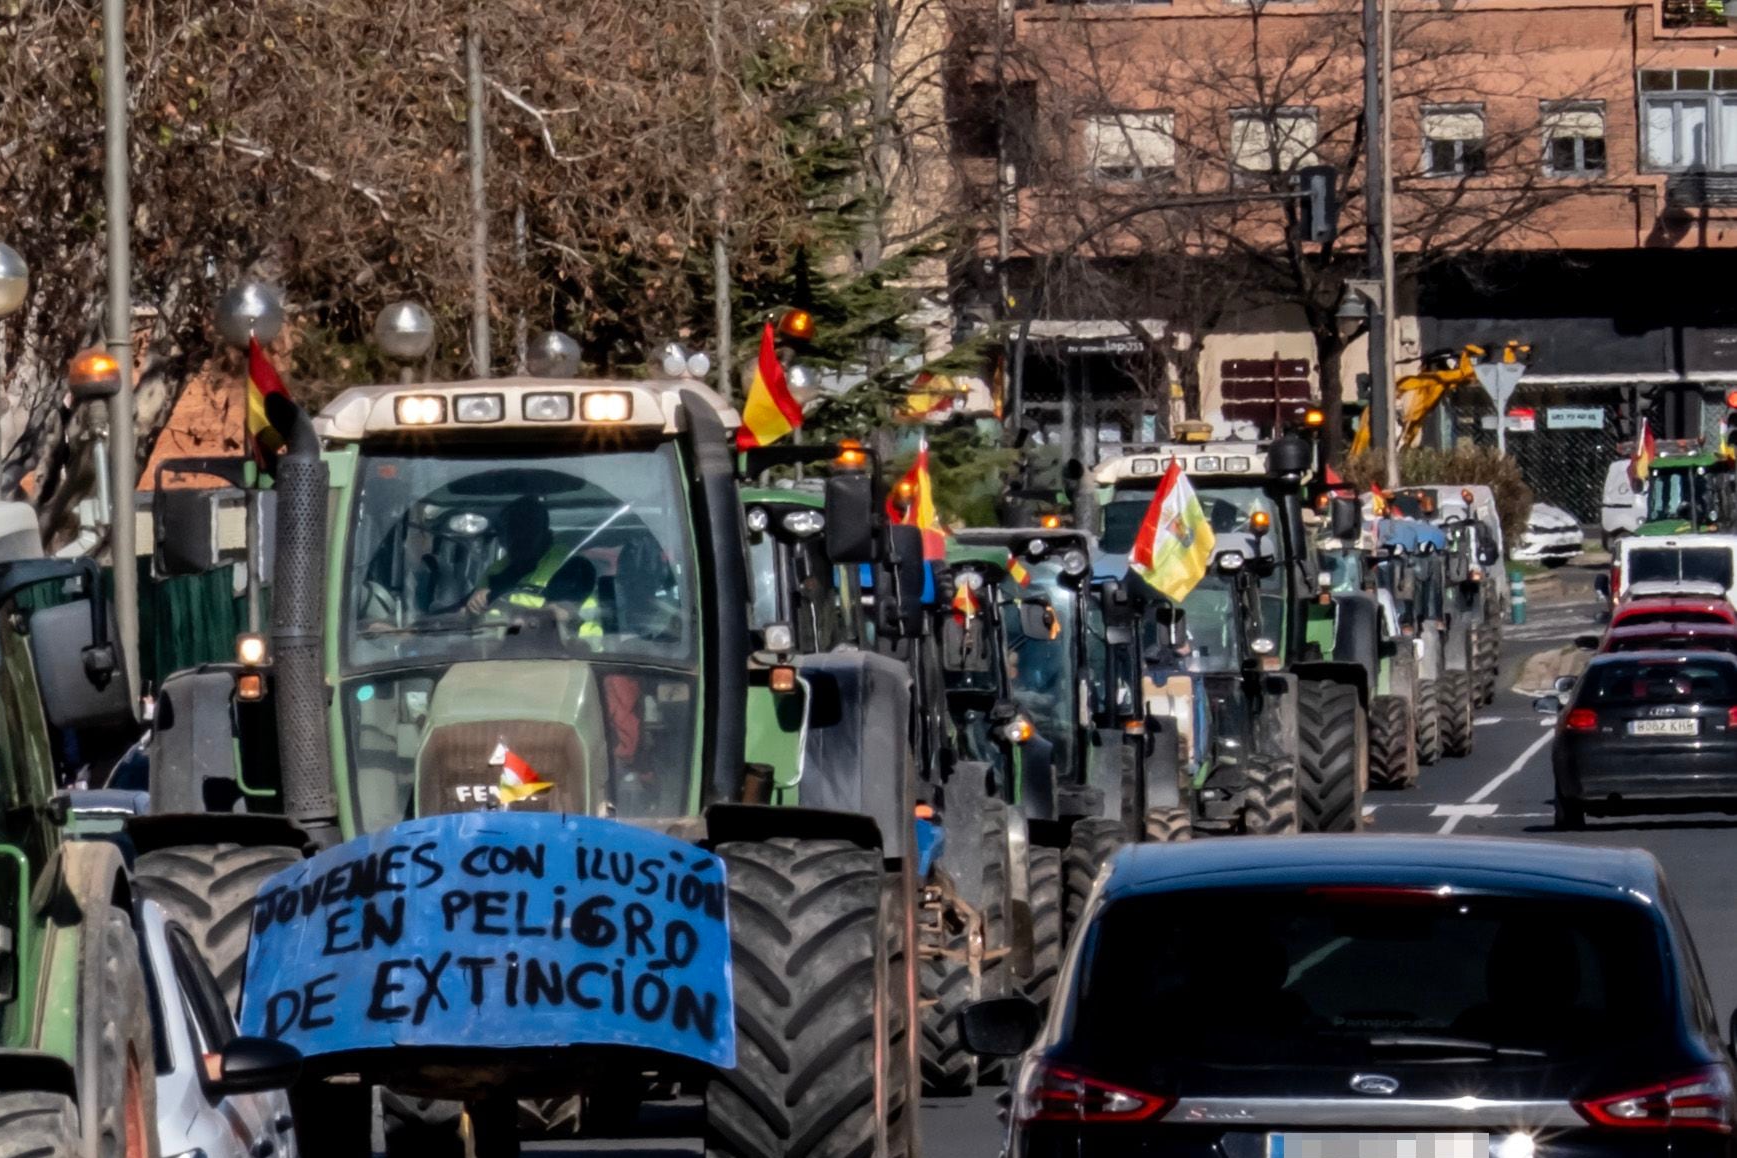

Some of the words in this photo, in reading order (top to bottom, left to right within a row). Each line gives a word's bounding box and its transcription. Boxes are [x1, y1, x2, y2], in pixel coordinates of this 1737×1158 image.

[254, 841, 444, 934] JÓVENES
[460, 843, 545, 879] CON
[322, 897, 405, 955] EN
[265, 973, 338, 1040] DE
